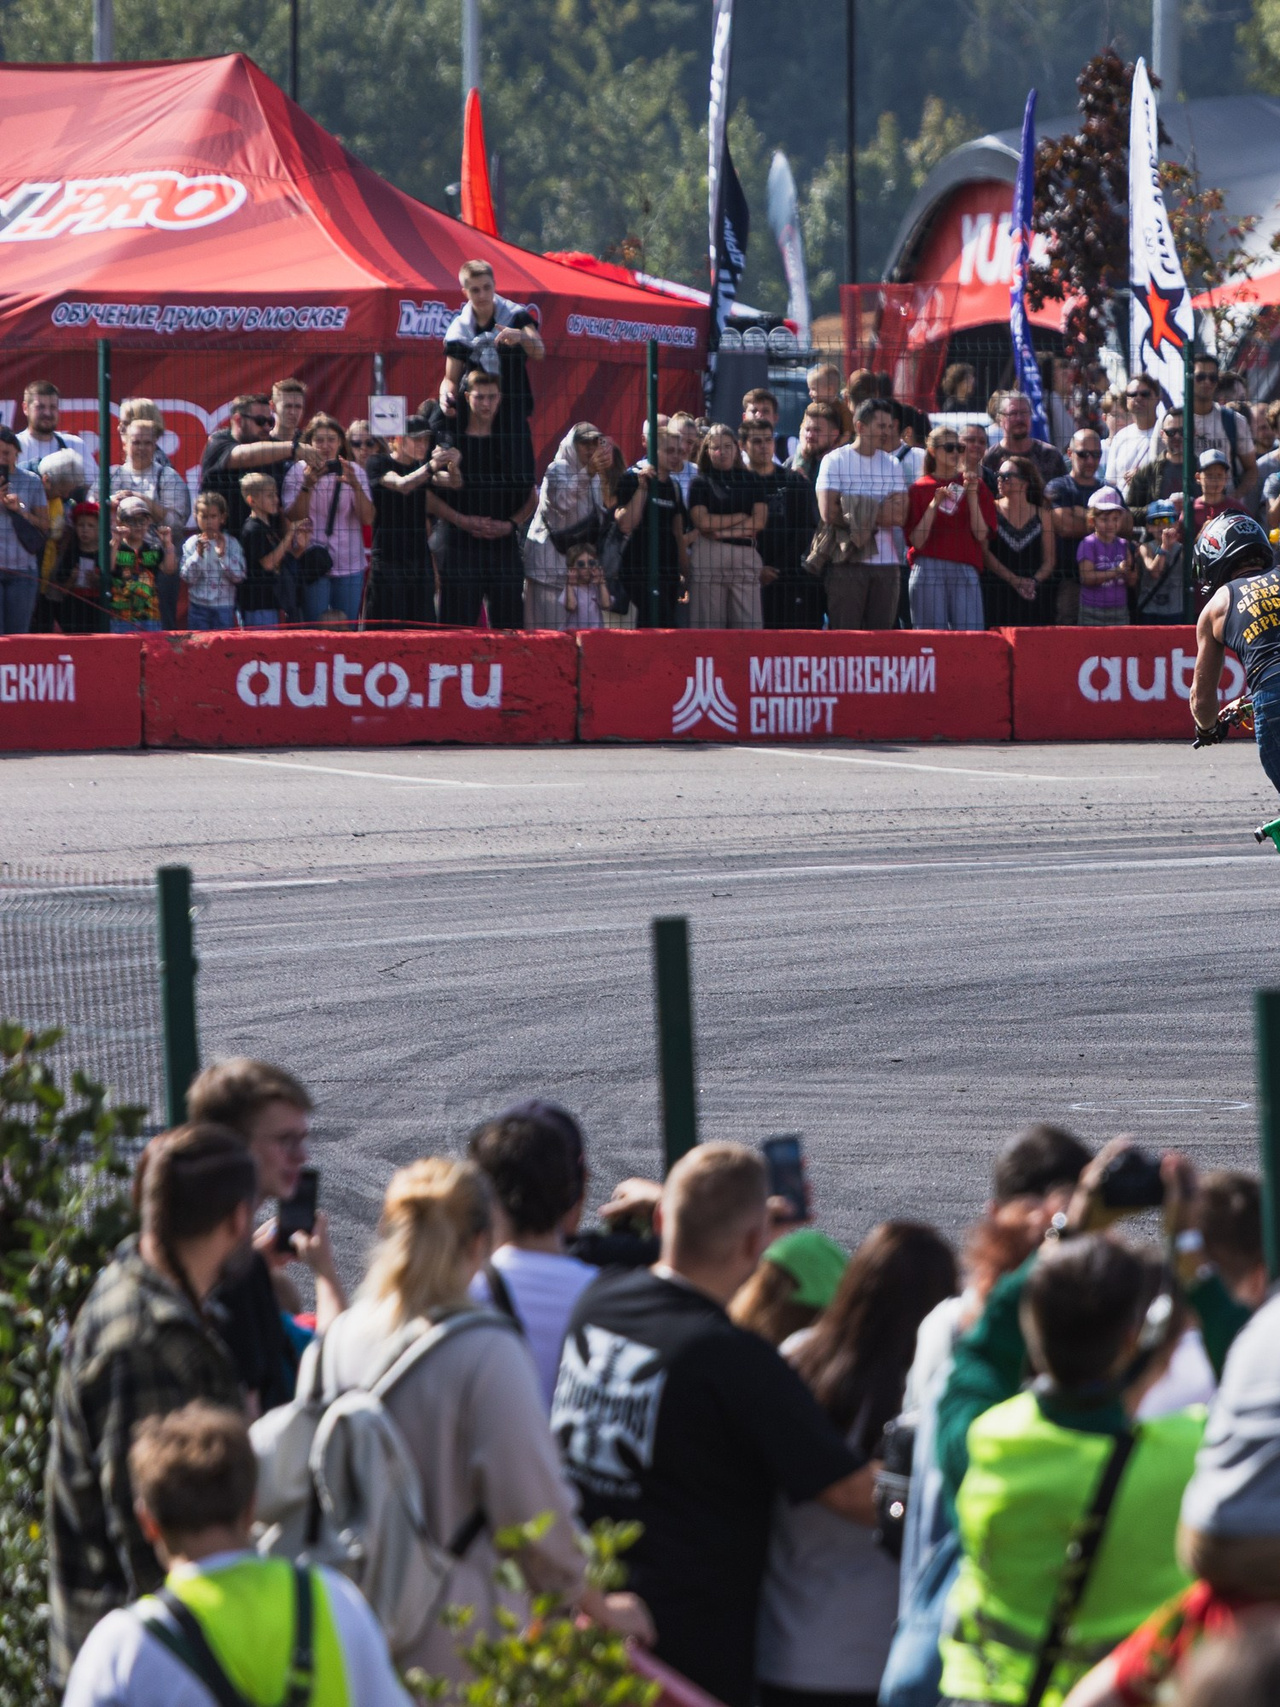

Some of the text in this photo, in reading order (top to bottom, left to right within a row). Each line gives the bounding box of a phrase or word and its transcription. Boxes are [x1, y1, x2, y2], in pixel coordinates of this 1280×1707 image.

[51, 302, 348, 334] ОБУЧЕНИЕ ДРИФТУ В МОСКВЕ
[1236, 584, 1280, 613] SLEEP
[1239, 577, 1269, 595] EAT
[236, 654, 502, 709] auto.ru
[749, 647, 936, 694] МОСКОВСКИЙ
[1078, 648, 1249, 702] auto
[749, 696, 838, 735] СПОРТ
